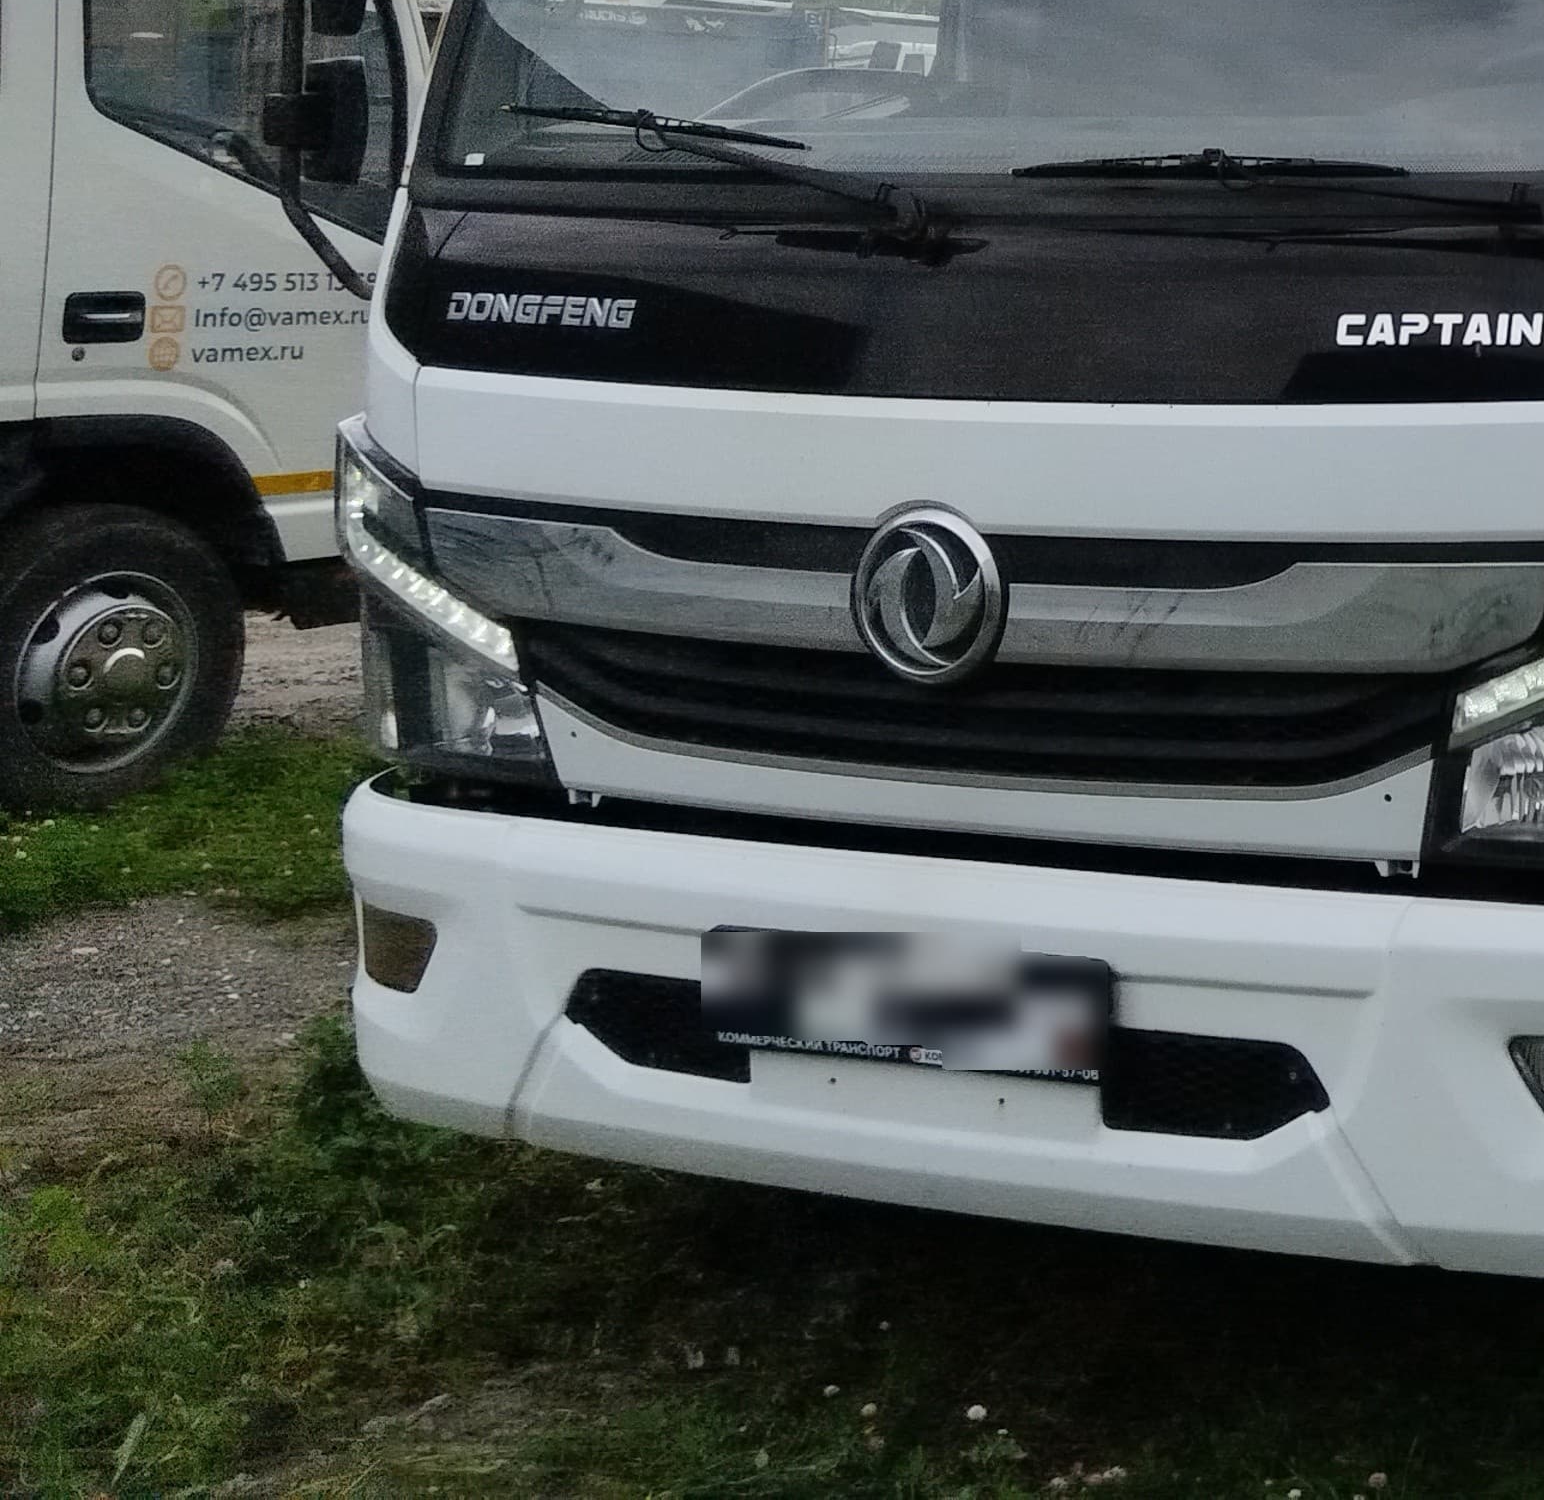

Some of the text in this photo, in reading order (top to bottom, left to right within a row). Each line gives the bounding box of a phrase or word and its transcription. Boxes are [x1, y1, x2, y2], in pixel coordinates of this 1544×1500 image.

[198, 273, 225, 292] +7
[232, 272, 277, 292] 495
[283, 272, 319, 292] 513
[446, 291, 638, 329] DONGFENG
[1336, 312, 1544, 346] CAPTAIN
[191, 345, 304, 364] vamex.ru
[826, 1040, 902, 1059] ТРАНСПОРТ
